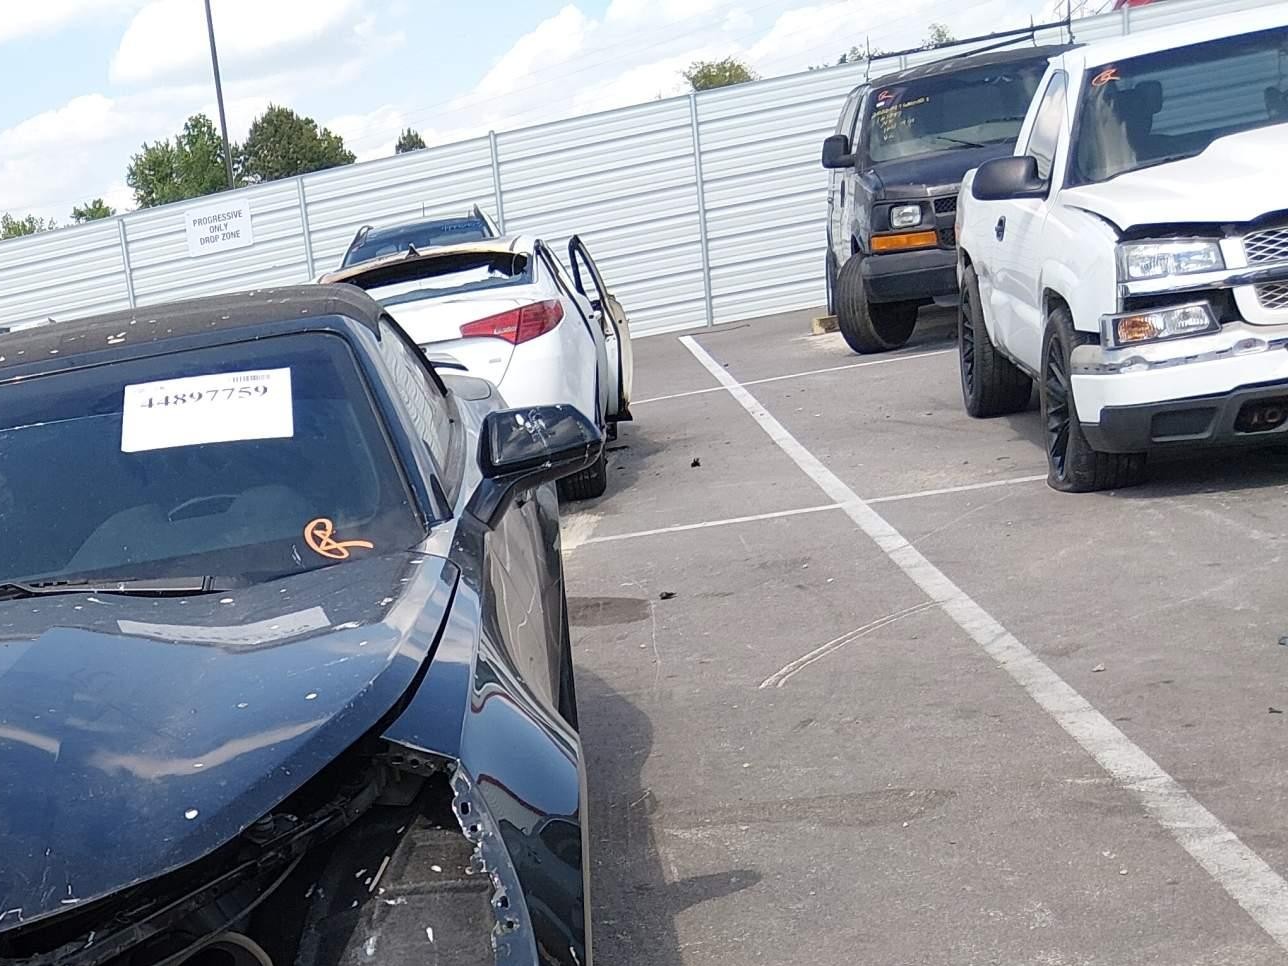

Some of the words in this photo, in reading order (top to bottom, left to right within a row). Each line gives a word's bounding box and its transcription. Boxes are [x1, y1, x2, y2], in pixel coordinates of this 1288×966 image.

[192, 209, 243, 227] PROGRESSIVE
[209, 222, 228, 233] ONLY
[200, 234, 220, 246] DROP
[221, 230, 241, 241] ZONE
[140, 385, 268, 408] 44897759
